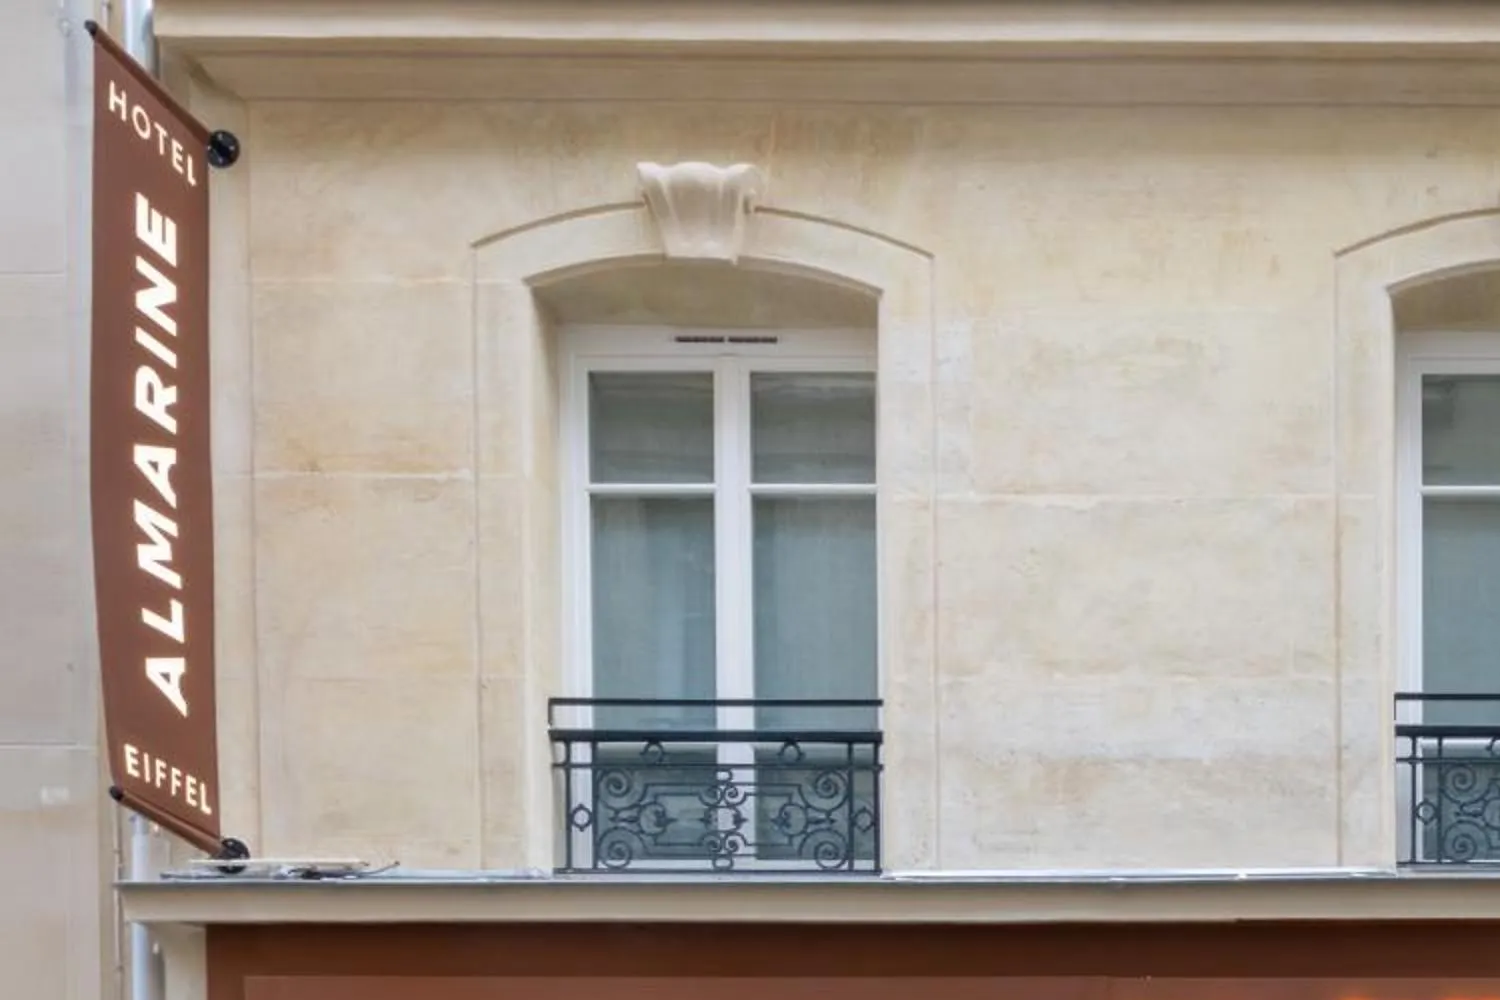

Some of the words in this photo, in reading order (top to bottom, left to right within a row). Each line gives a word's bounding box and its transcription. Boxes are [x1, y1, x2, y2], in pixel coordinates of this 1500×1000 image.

[109, 80, 196, 186] HOTEL
[134, 192, 188, 718] ALMARINE
[124, 743, 212, 815] EIFFEL
